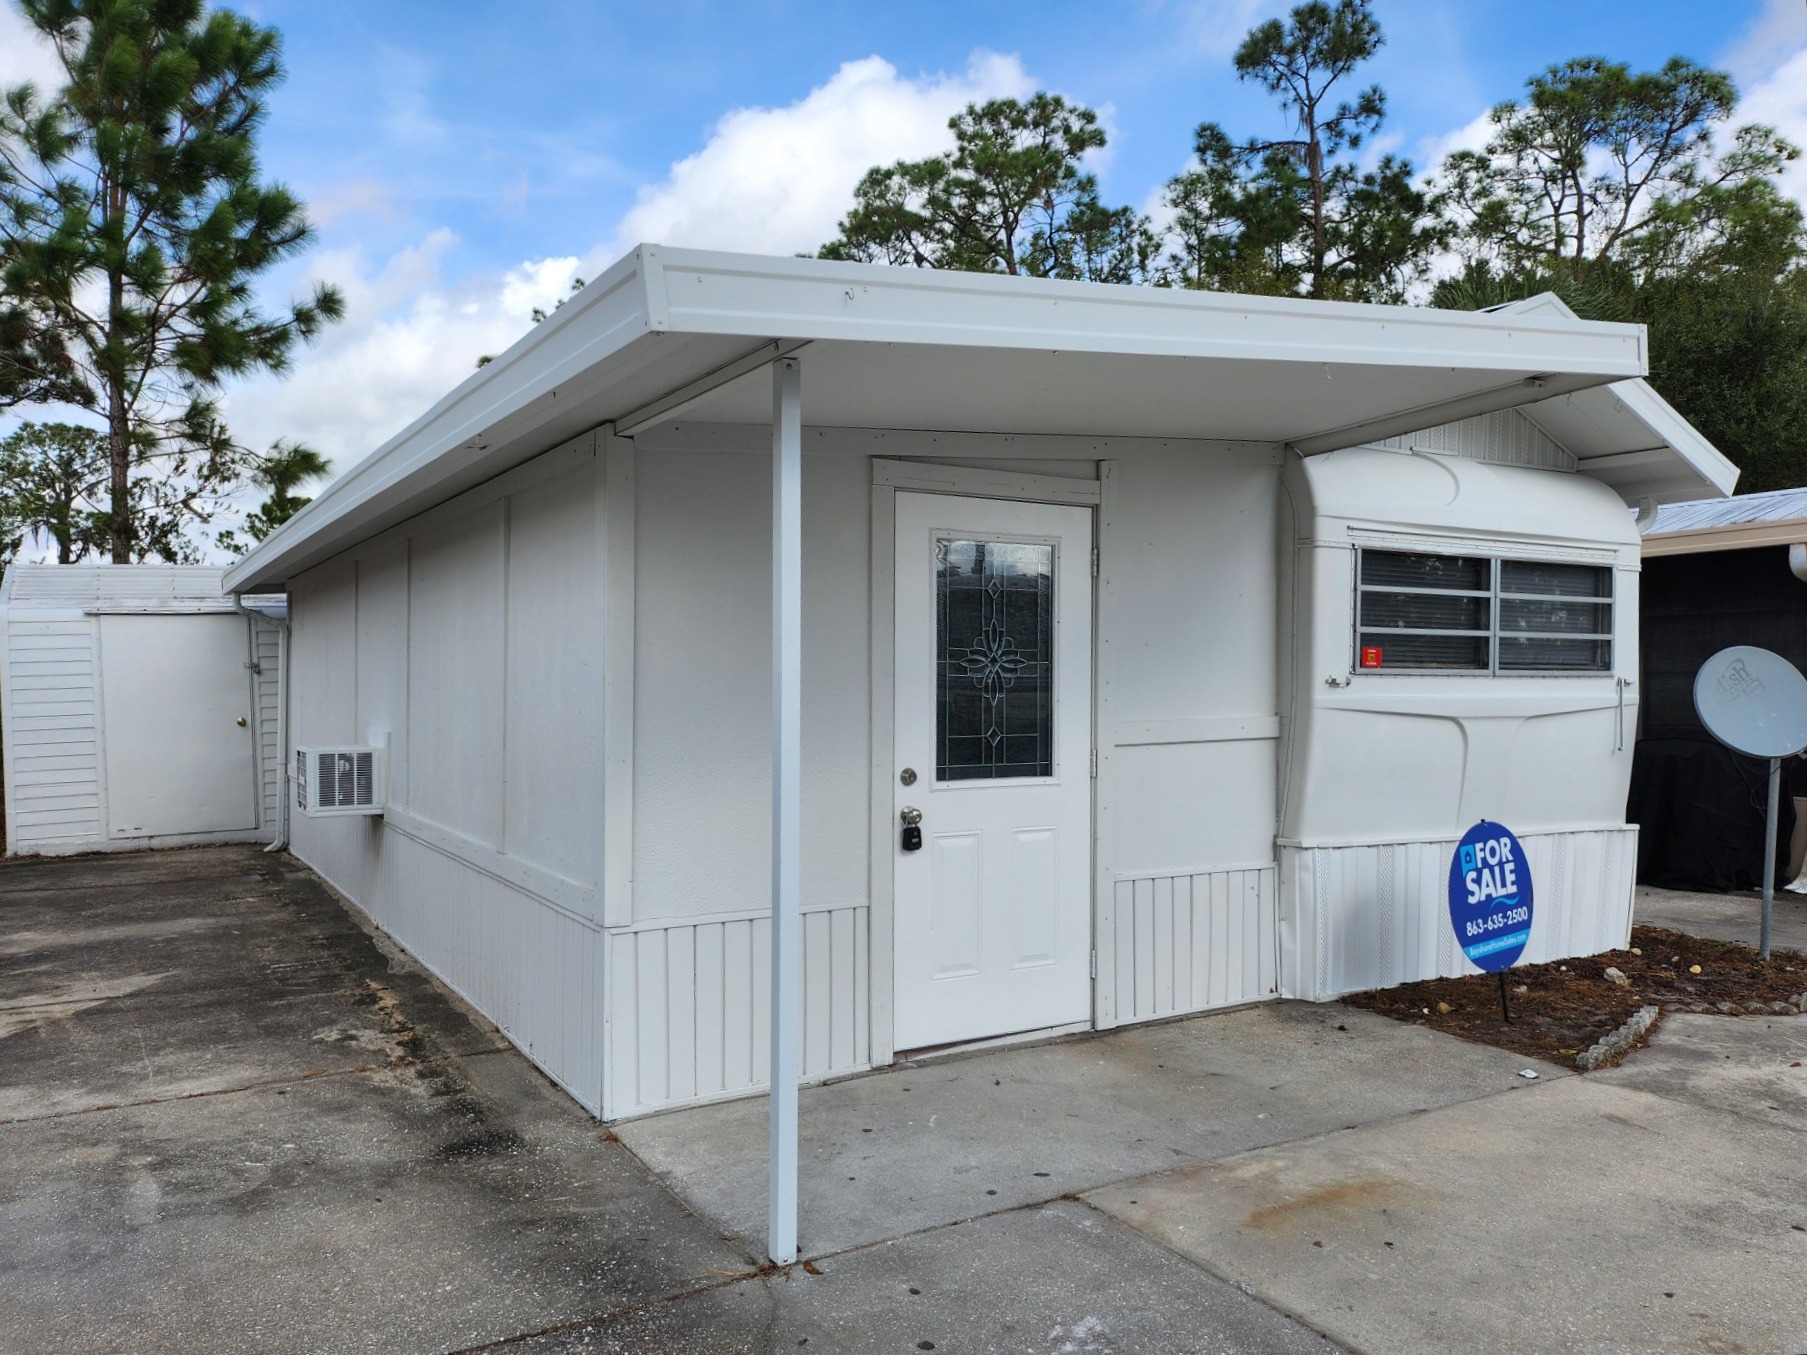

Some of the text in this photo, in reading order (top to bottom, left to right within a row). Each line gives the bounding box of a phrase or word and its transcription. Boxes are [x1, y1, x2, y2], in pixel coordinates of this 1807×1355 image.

[1475, 837, 1514, 868] FOR
[1466, 862, 1517, 904] SALE
[1466, 906, 1528, 937] 863-635-2500
